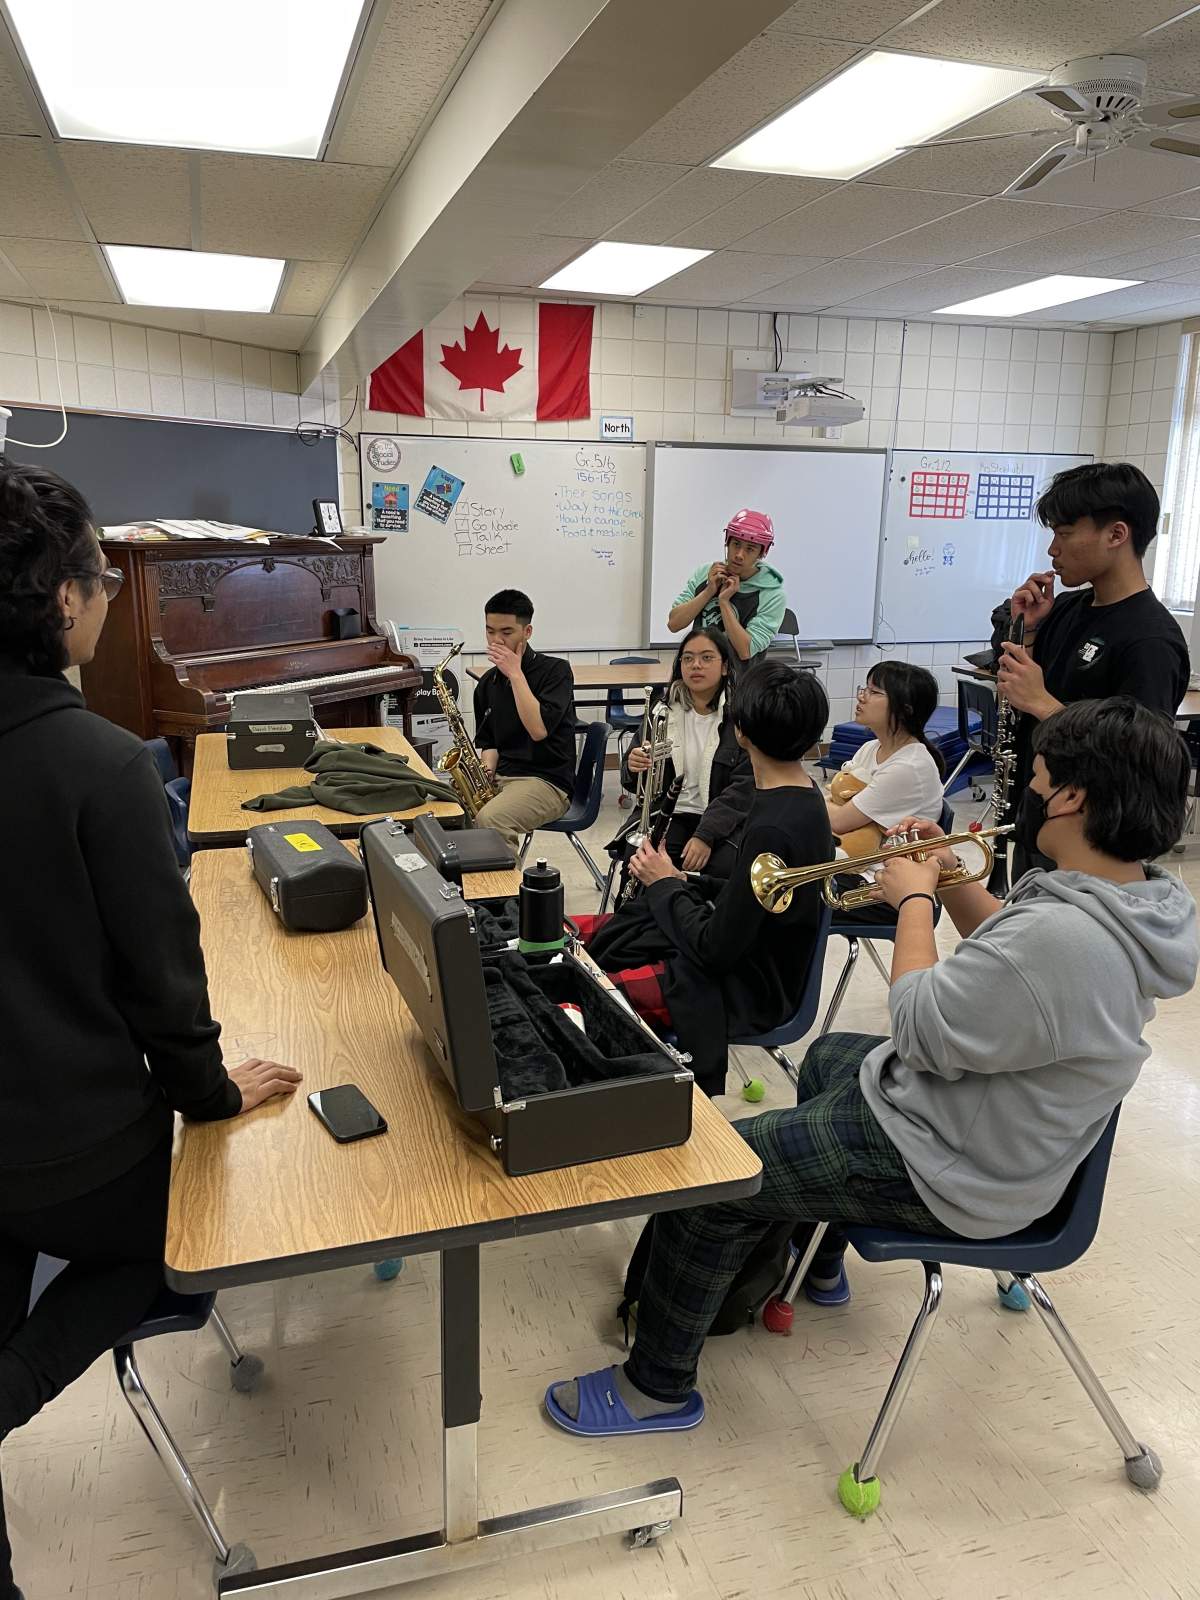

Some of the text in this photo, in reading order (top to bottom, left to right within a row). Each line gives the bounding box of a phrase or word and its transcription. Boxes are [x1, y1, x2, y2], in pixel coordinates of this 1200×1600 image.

[604, 422, 630, 433] North
[470, 503, 505, 518] Story
[472, 531, 503, 541] Talk
[475, 542, 512, 556] Sheet
